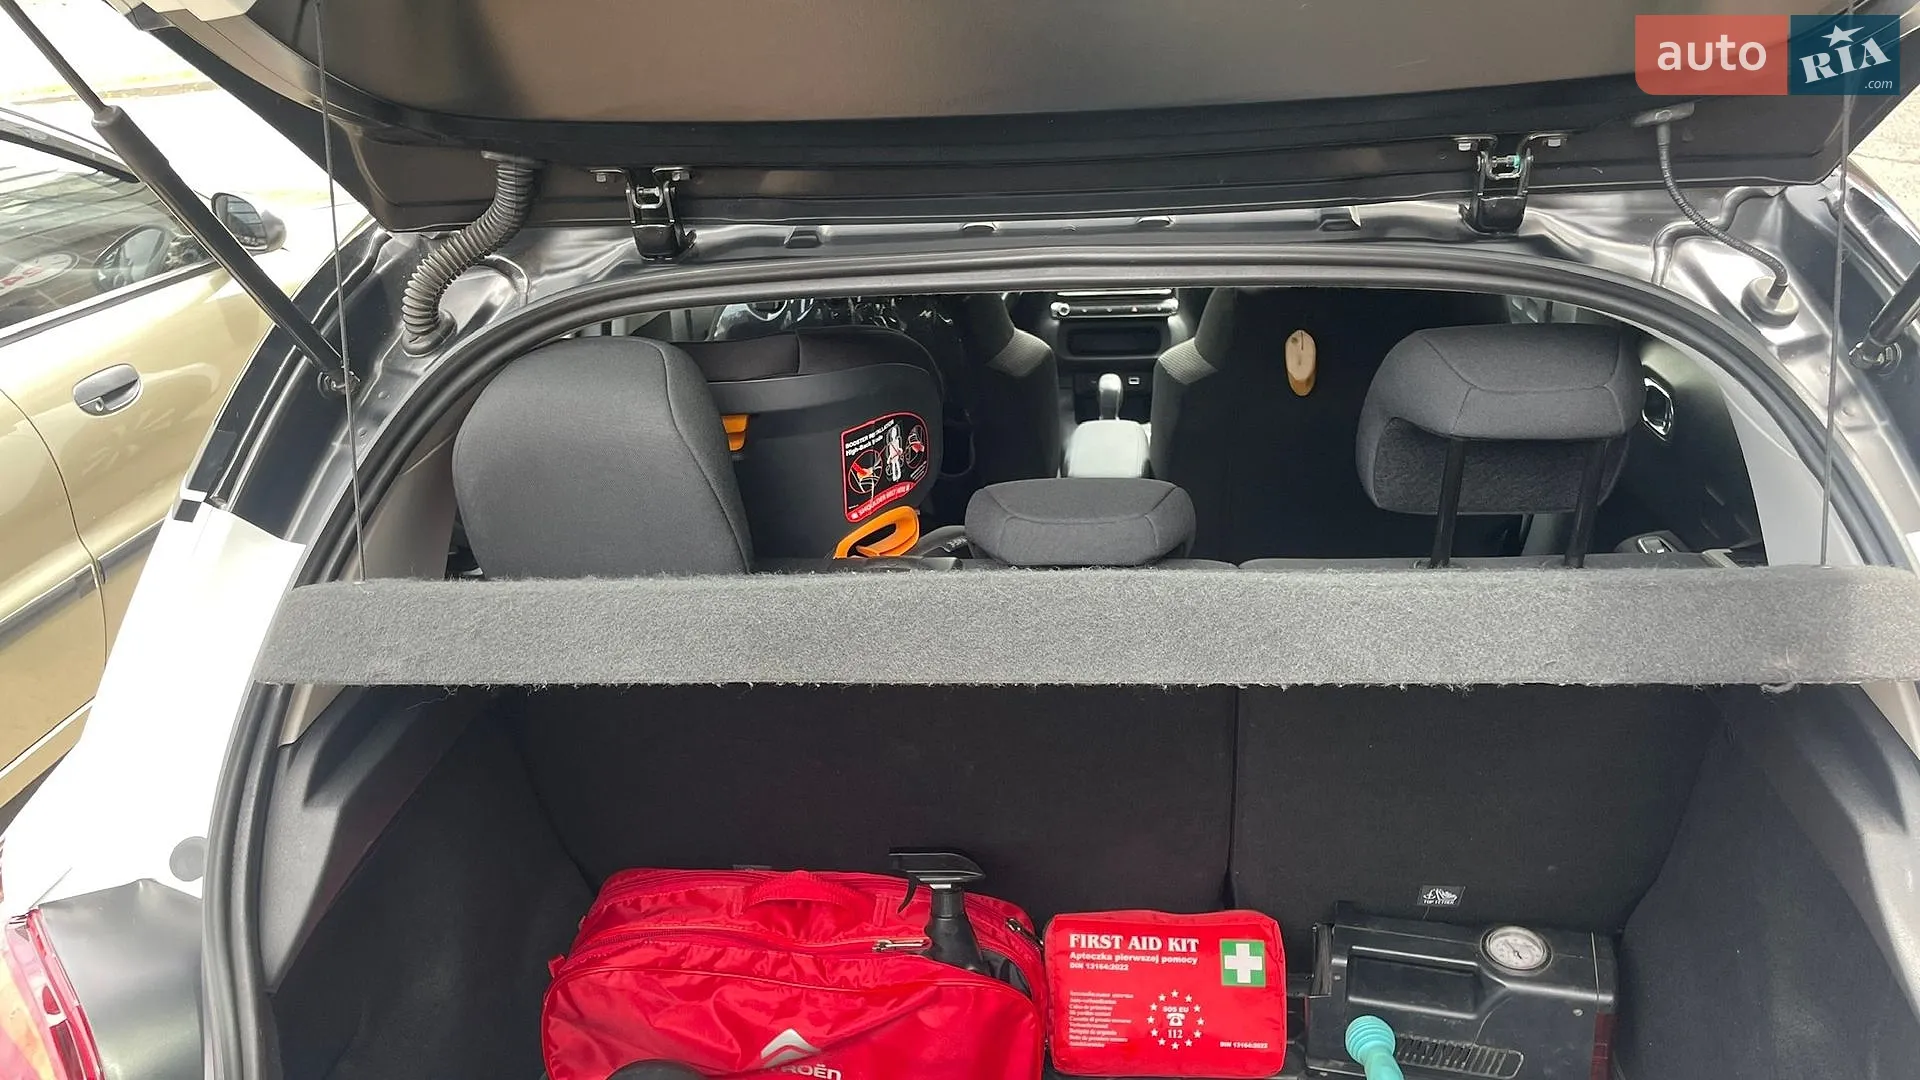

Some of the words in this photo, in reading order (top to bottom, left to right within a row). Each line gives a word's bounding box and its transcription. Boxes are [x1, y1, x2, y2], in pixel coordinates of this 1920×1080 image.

[1068, 933, 1124, 950] FIRST
[1127, 935, 1163, 951] AID
[1167, 937, 1200, 953] KIT
[1069, 952, 1113, 962] Apteczka
[1115, 953, 1159, 964] pierwszej
[1161, 955, 1199, 965] pomocy
[1167, 1029, 1184, 1039] 112
